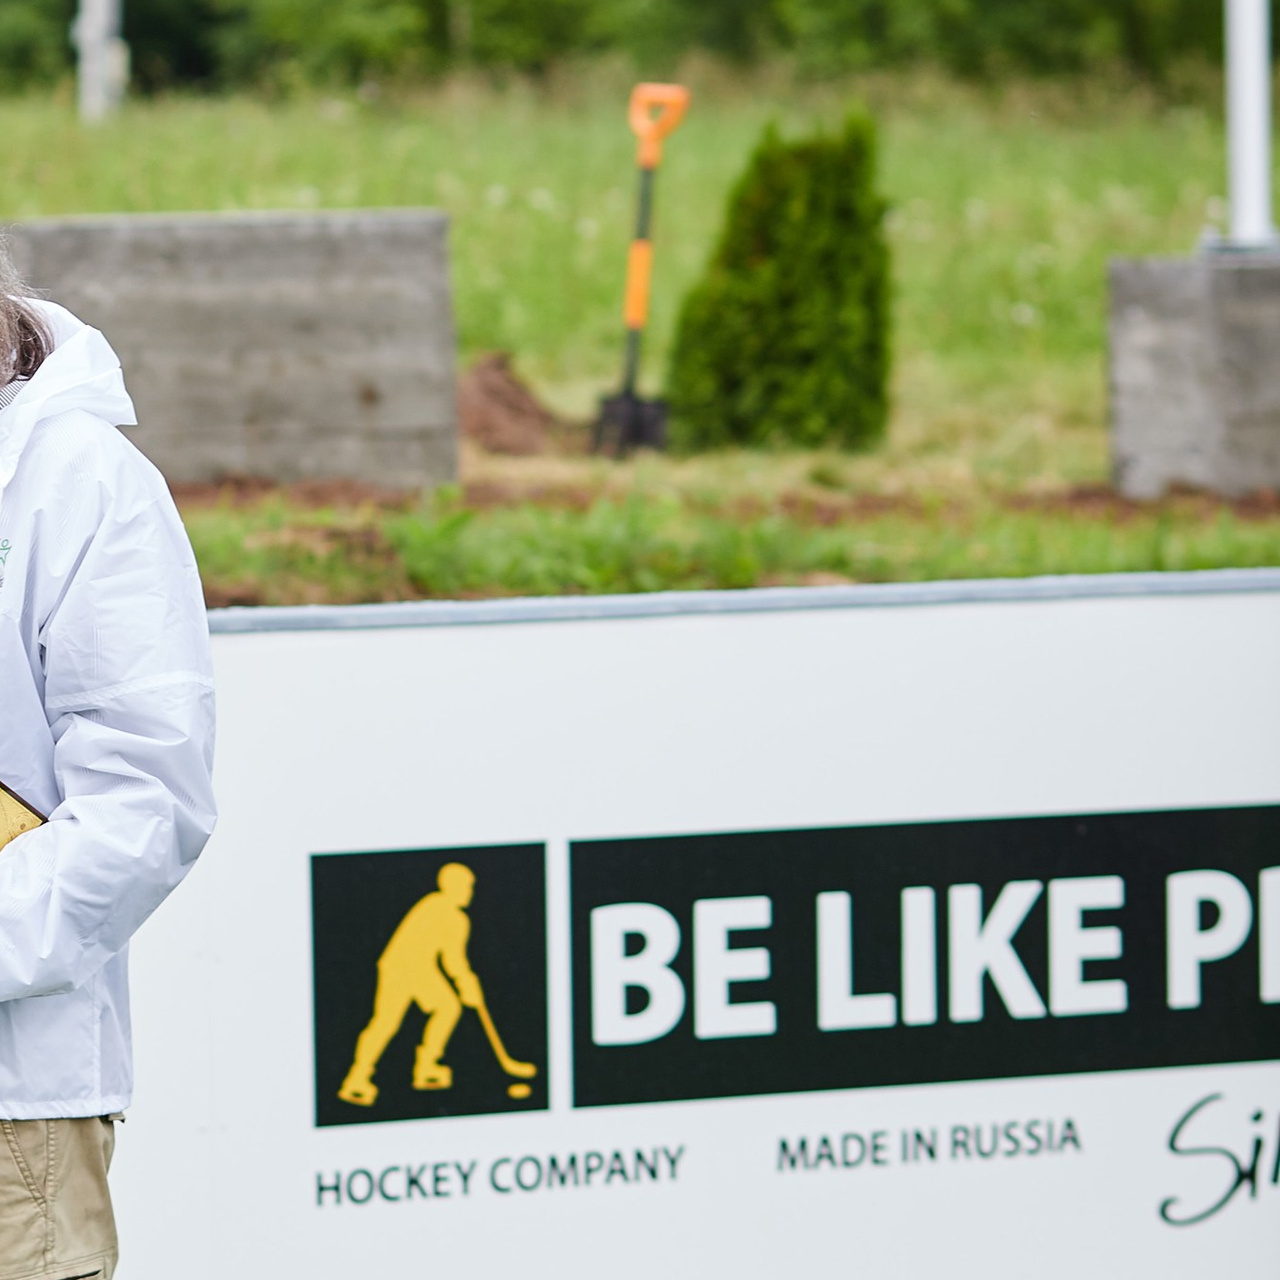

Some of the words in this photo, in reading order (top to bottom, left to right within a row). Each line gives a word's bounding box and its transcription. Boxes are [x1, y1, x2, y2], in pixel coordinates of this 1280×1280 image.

[590, 895, 777, 1047] BE
[816, 875, 1129, 1032] LIKE
[777, 1133, 888, 1172] MADE
[900, 1127, 940, 1163] IN
[950, 1118, 1082, 1160] RUSSIA
[316, 1160, 476, 1207] HOCKEY
[489, 1147, 686, 1195] COMPANY
